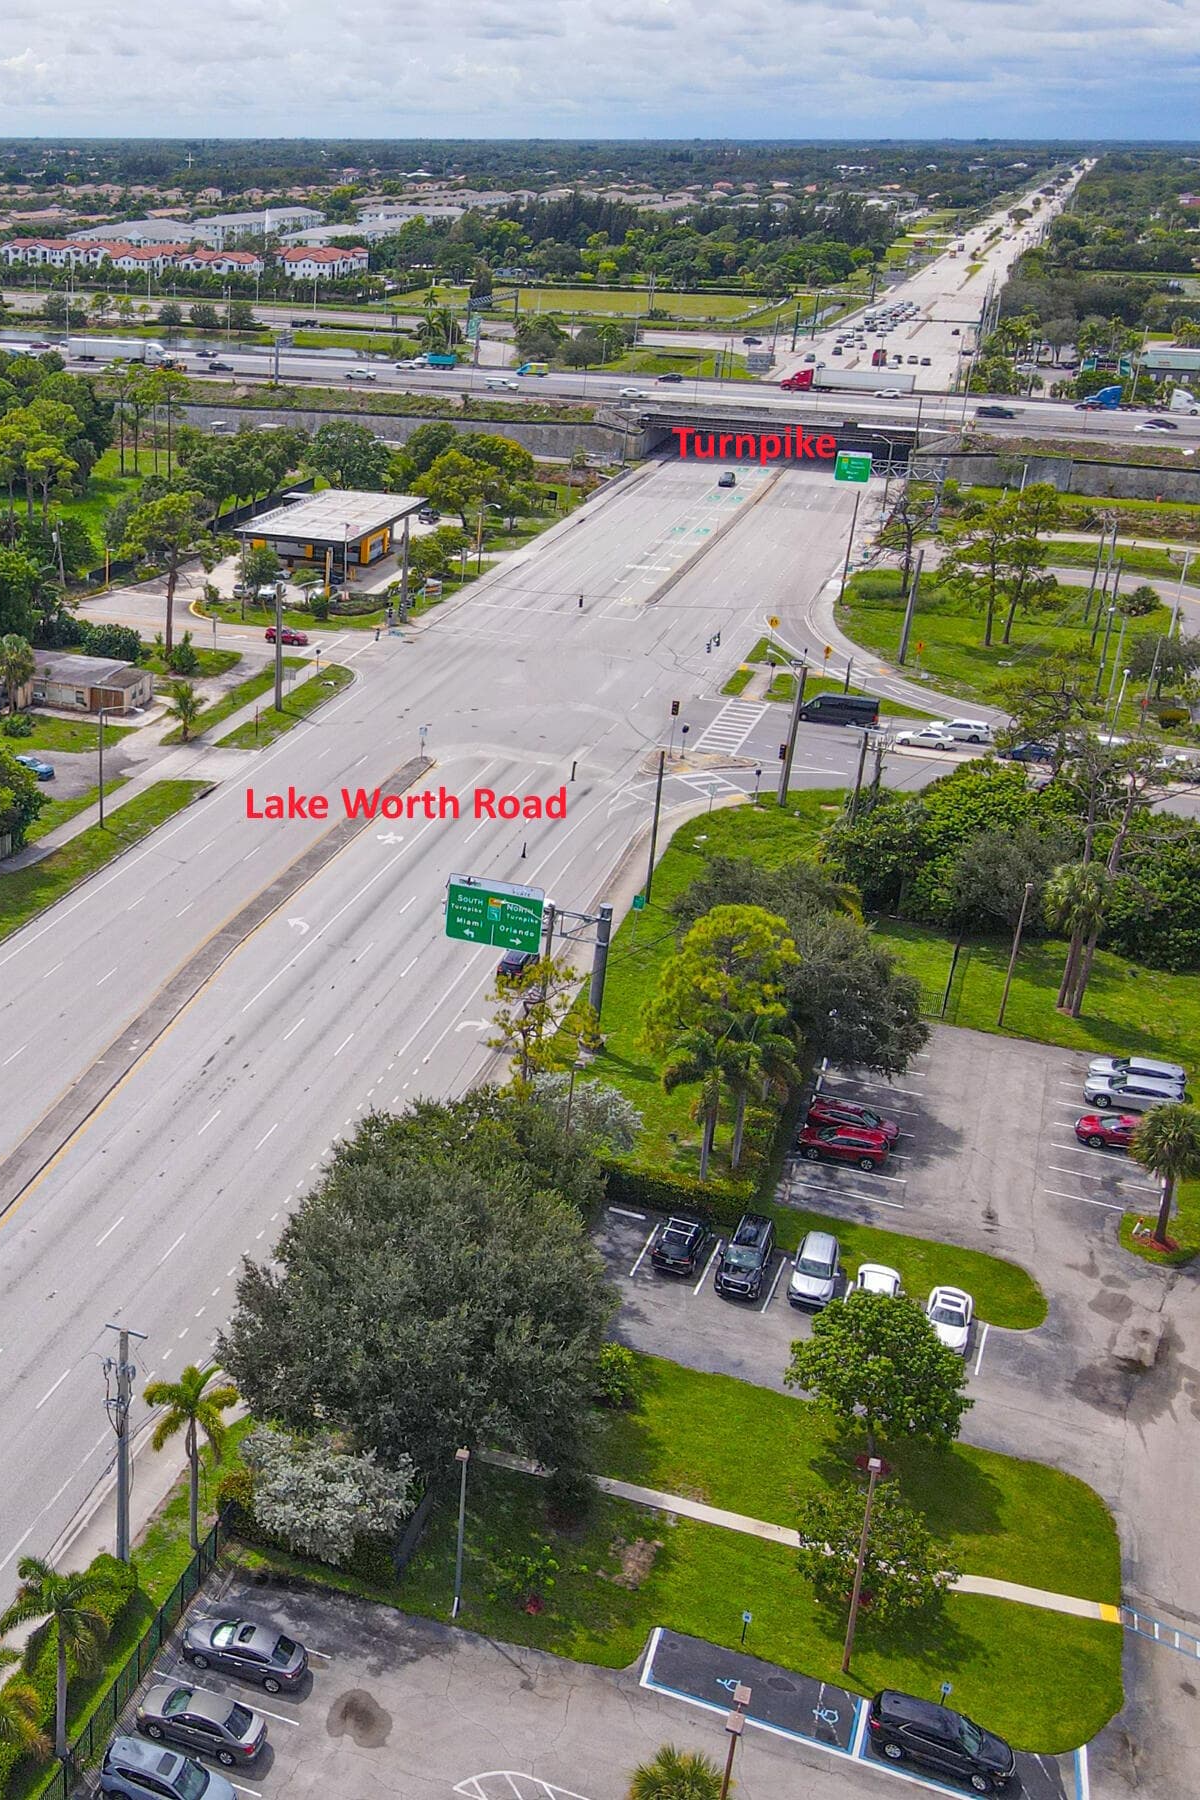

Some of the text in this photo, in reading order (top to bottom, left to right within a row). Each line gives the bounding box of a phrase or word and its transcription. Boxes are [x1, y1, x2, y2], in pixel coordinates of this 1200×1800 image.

[457, 894, 484, 906] SOUTH
[451, 903, 483, 914] Turnpike
[456, 916, 483, 928] Miami
[506, 913, 539, 925] Turnpike
[499, 924, 535, 937] Orlando
